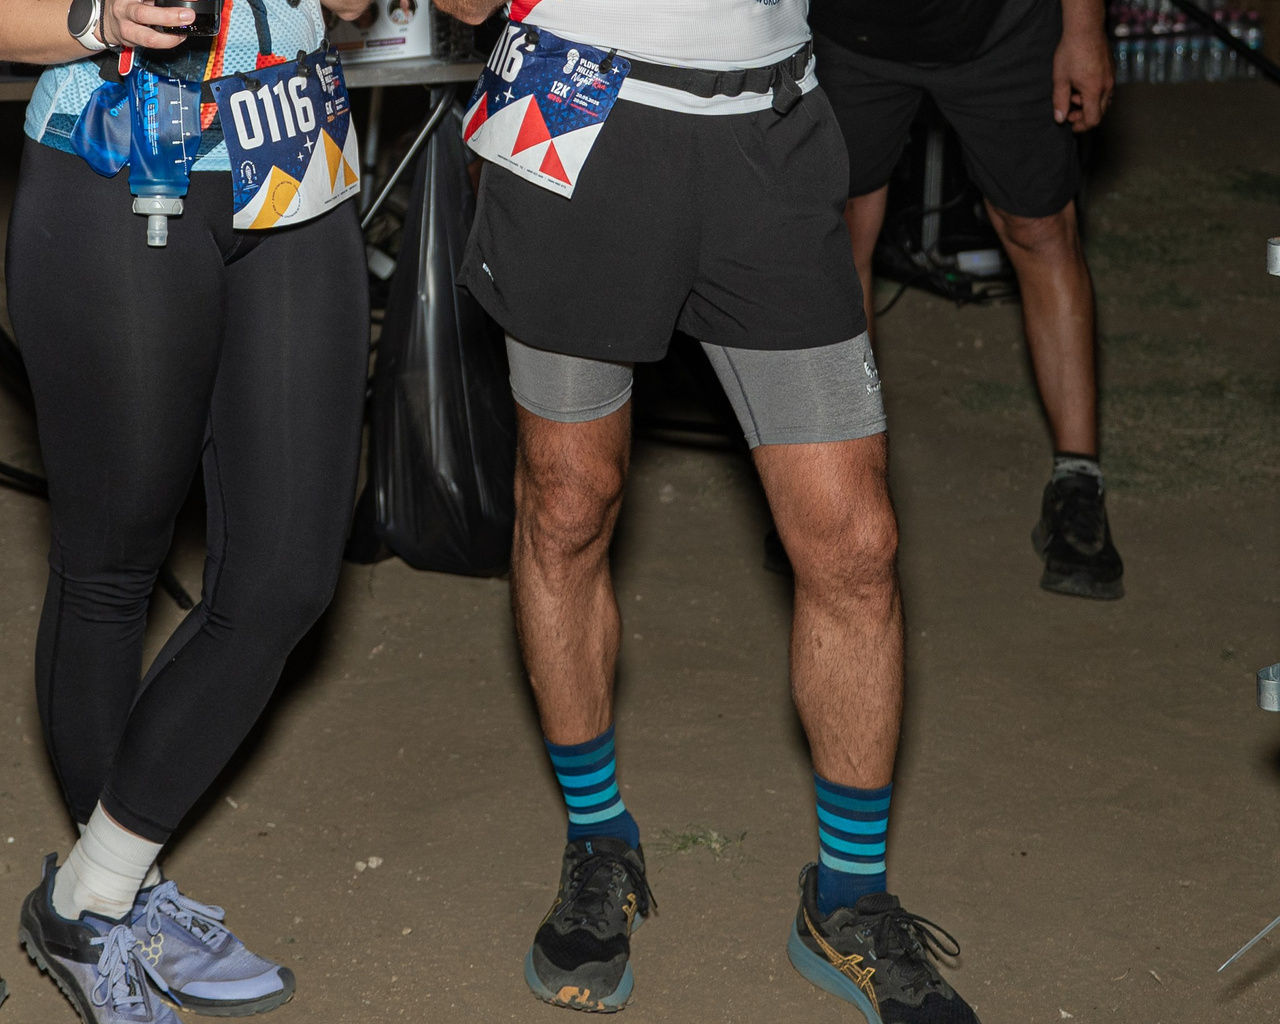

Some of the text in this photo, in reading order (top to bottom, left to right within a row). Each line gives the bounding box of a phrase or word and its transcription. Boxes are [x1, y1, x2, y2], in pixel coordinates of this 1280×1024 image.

[571, 72, 594, 88] Night
[576, 65, 595, 78] HILLS
[550, 80, 571, 99] 12K
[229, 75, 316, 151] 0116
